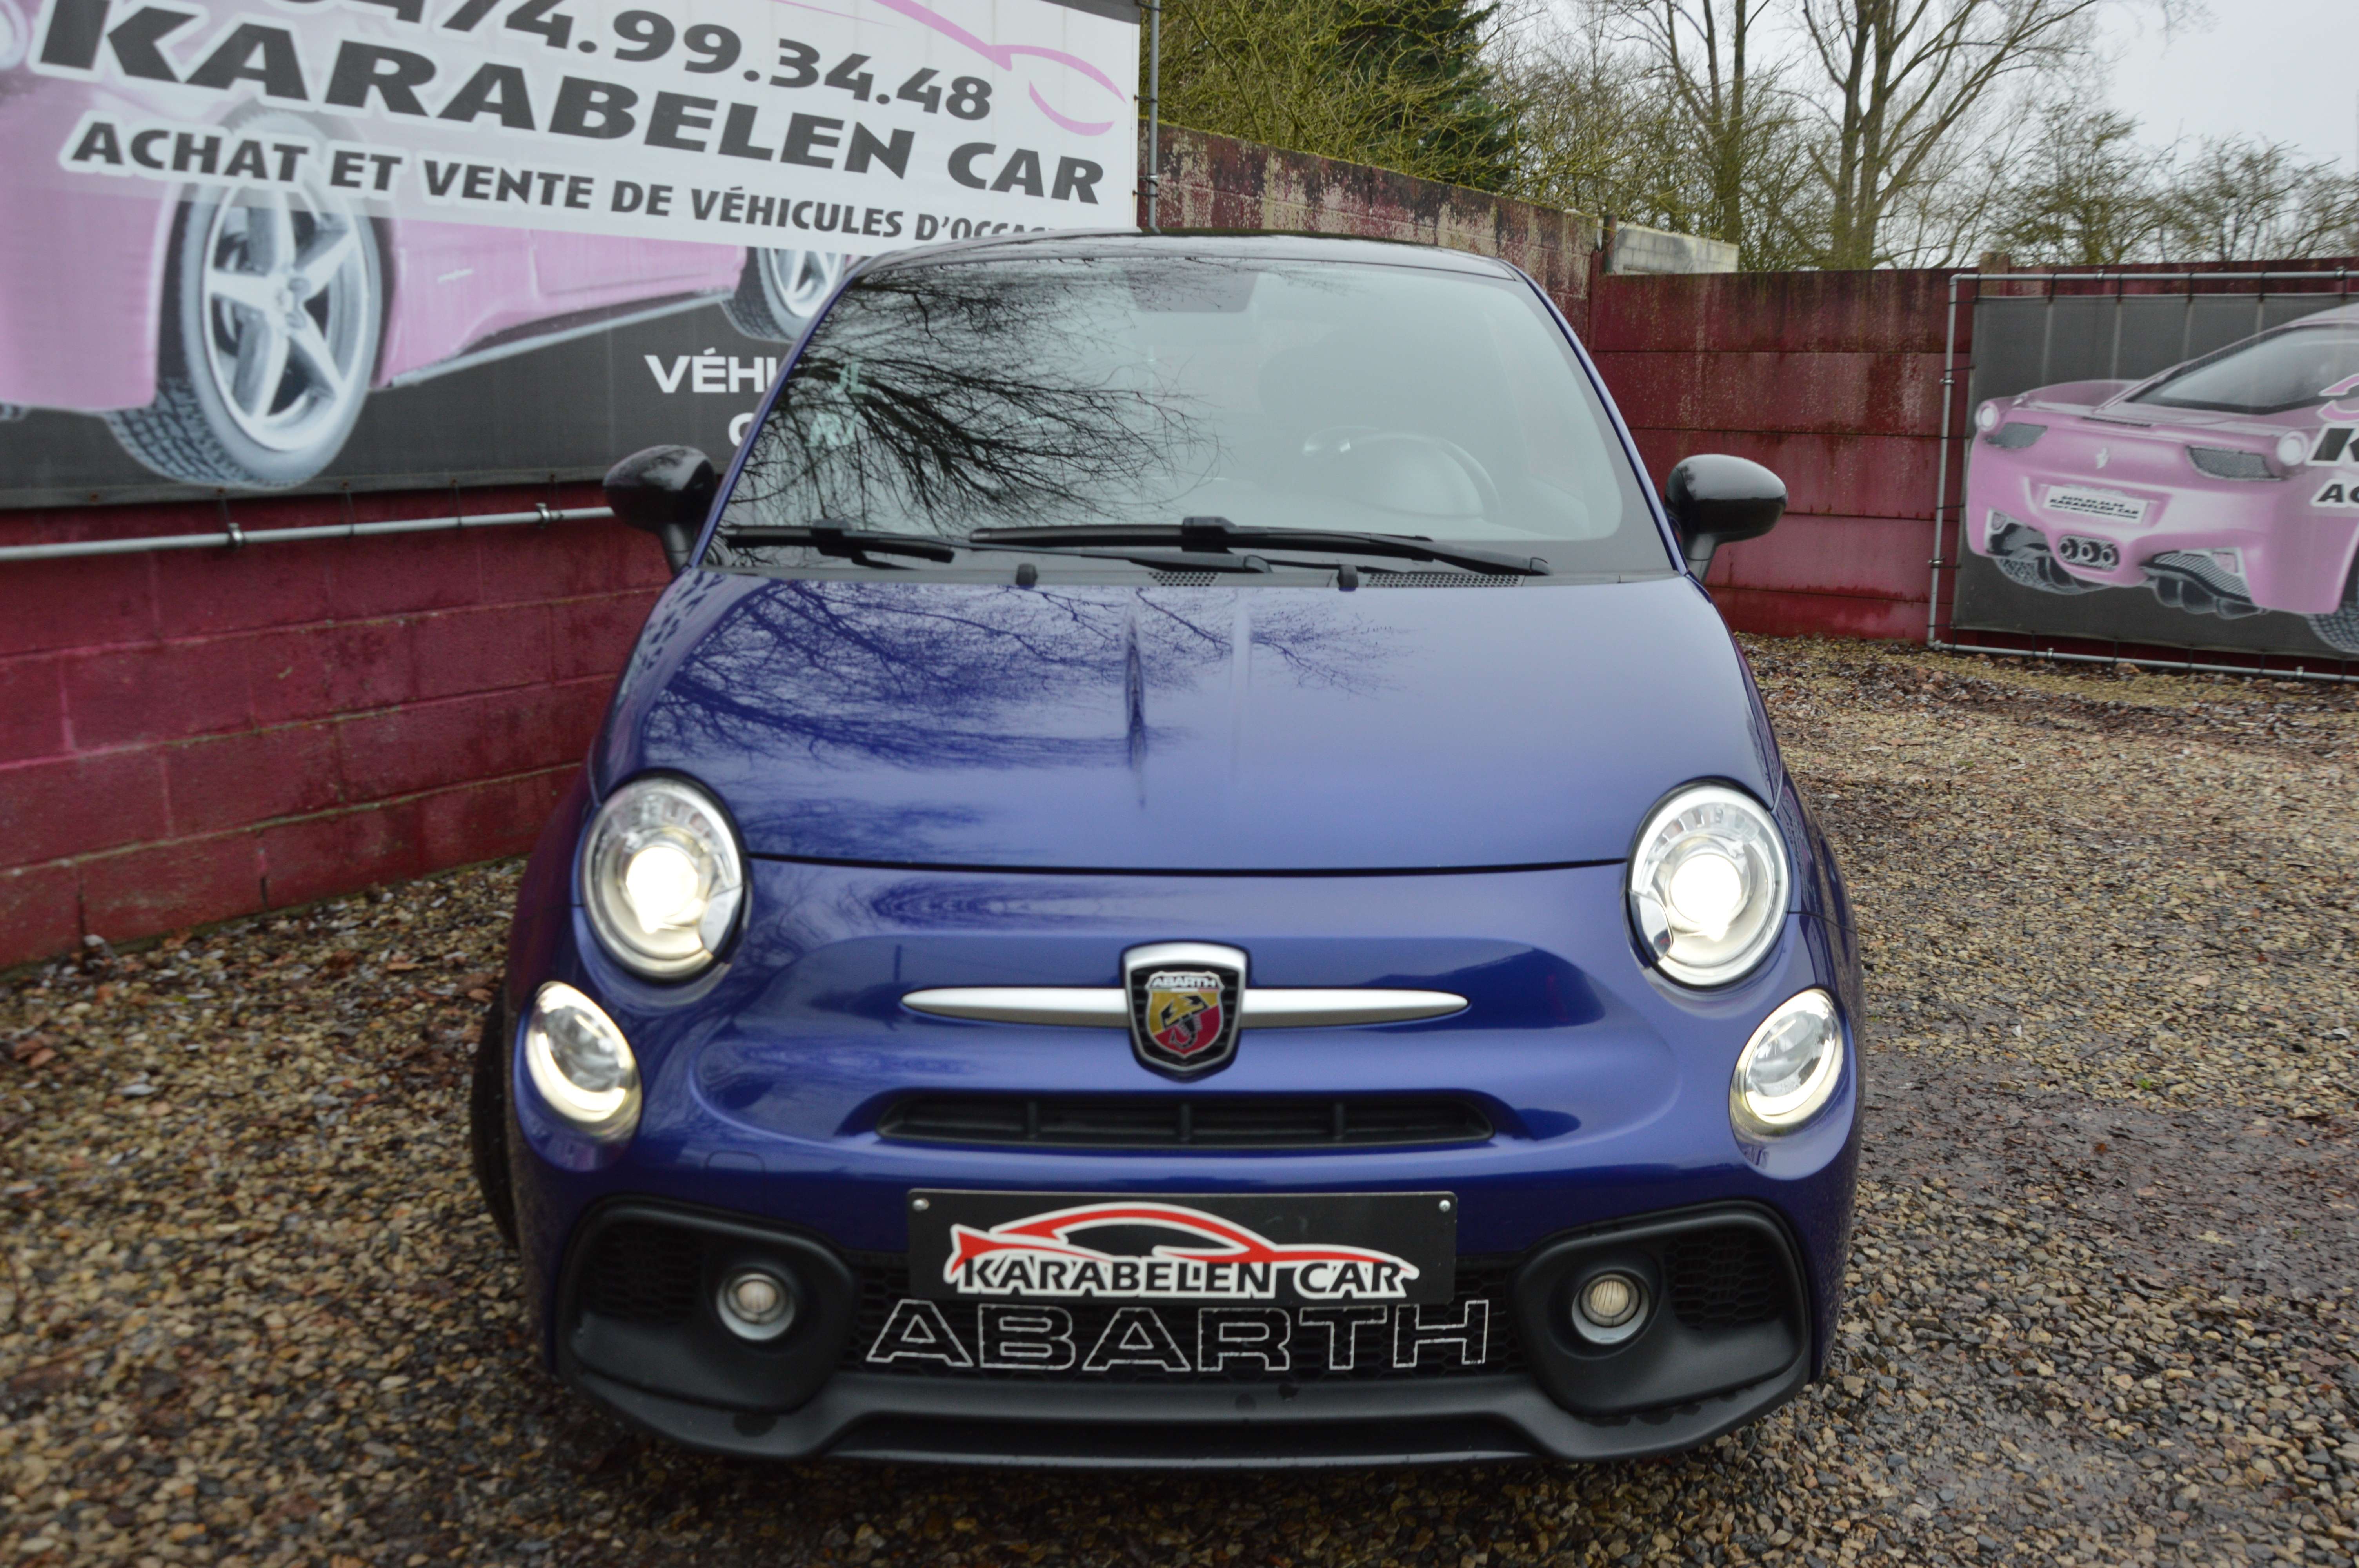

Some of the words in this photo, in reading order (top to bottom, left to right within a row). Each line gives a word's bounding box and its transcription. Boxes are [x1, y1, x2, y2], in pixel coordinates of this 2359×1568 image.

[40, 0, 915, 179] KARABELEN
[948, 142, 1103, 204] CAR
[279, 0, 992, 120] 74.99.34.48
[72, 122, 308, 182] ACHAT
[330, 150, 402, 191] ET
[425, 160, 594, 209] VENTE
[611, 180, 673, 216] DE
[691, 186, 903, 238] VÉHICULES
[1151, 977, 1216, 987] ABARTH
[964, 1259, 1271, 1292] KARABELEN
[1299, 1262, 1401, 1293] CAR
[866, 1299, 1489, 1372] ABARTH
